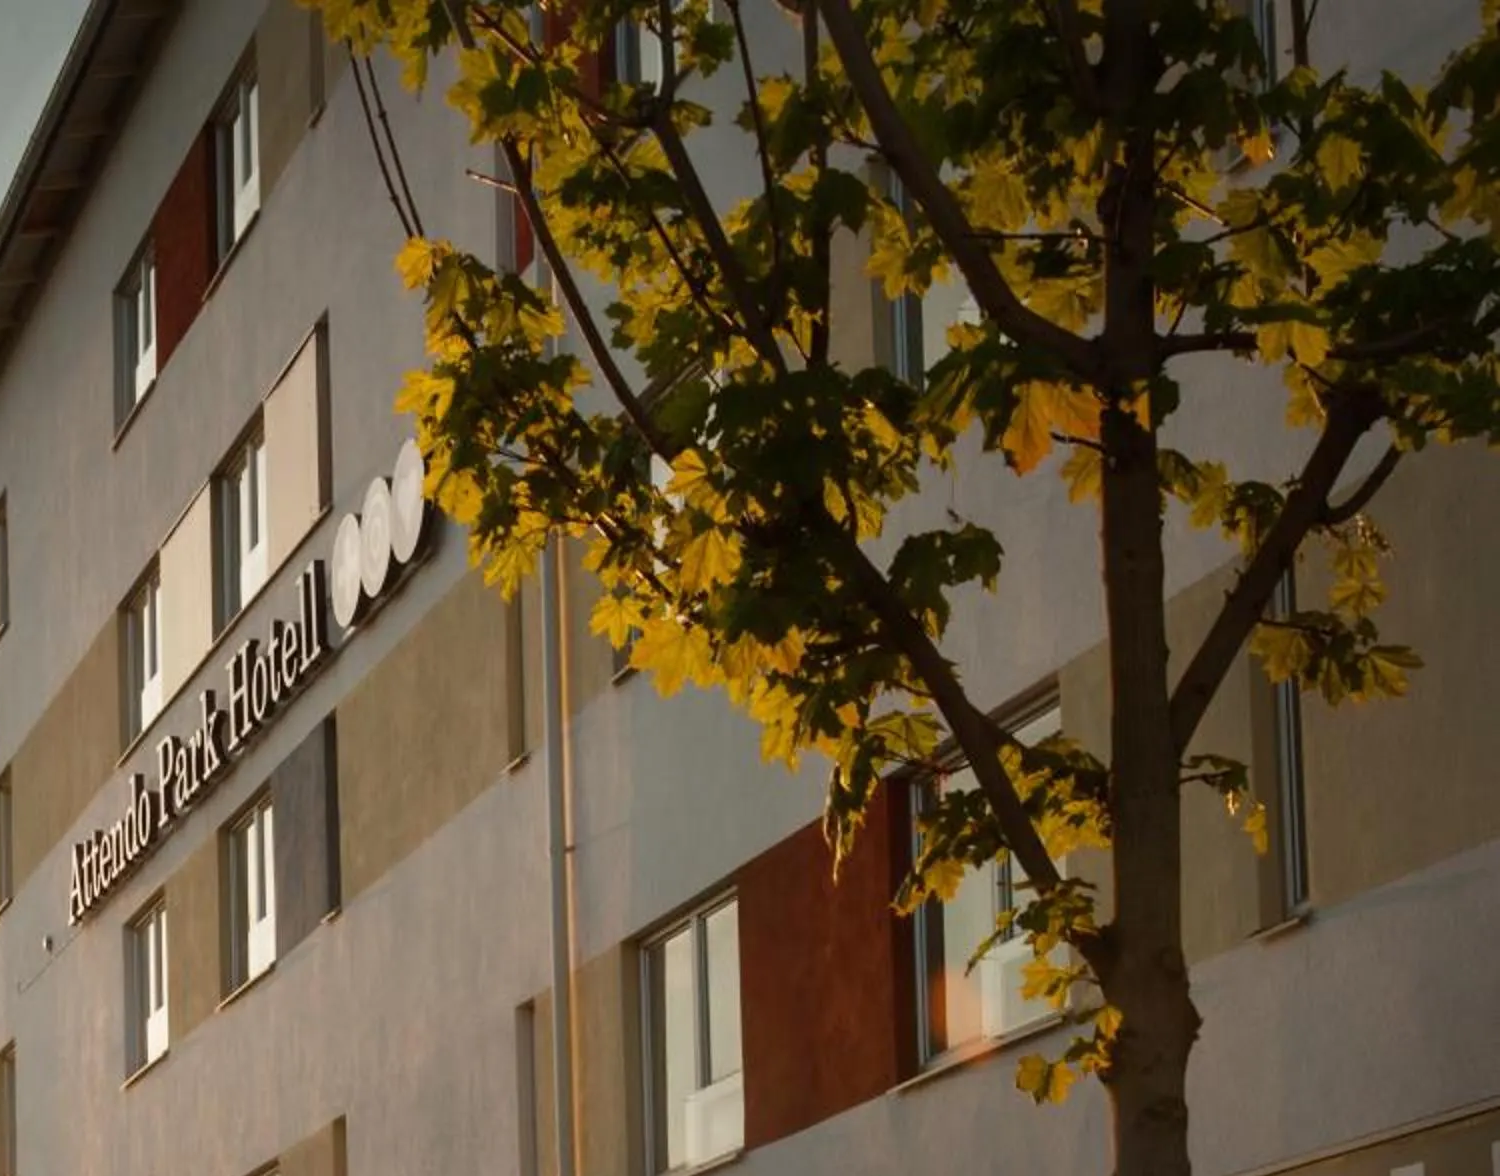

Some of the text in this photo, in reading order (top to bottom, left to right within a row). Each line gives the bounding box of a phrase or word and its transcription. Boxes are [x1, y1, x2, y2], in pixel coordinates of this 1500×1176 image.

[67, 558, 327, 926] Attendo Park Hotell
